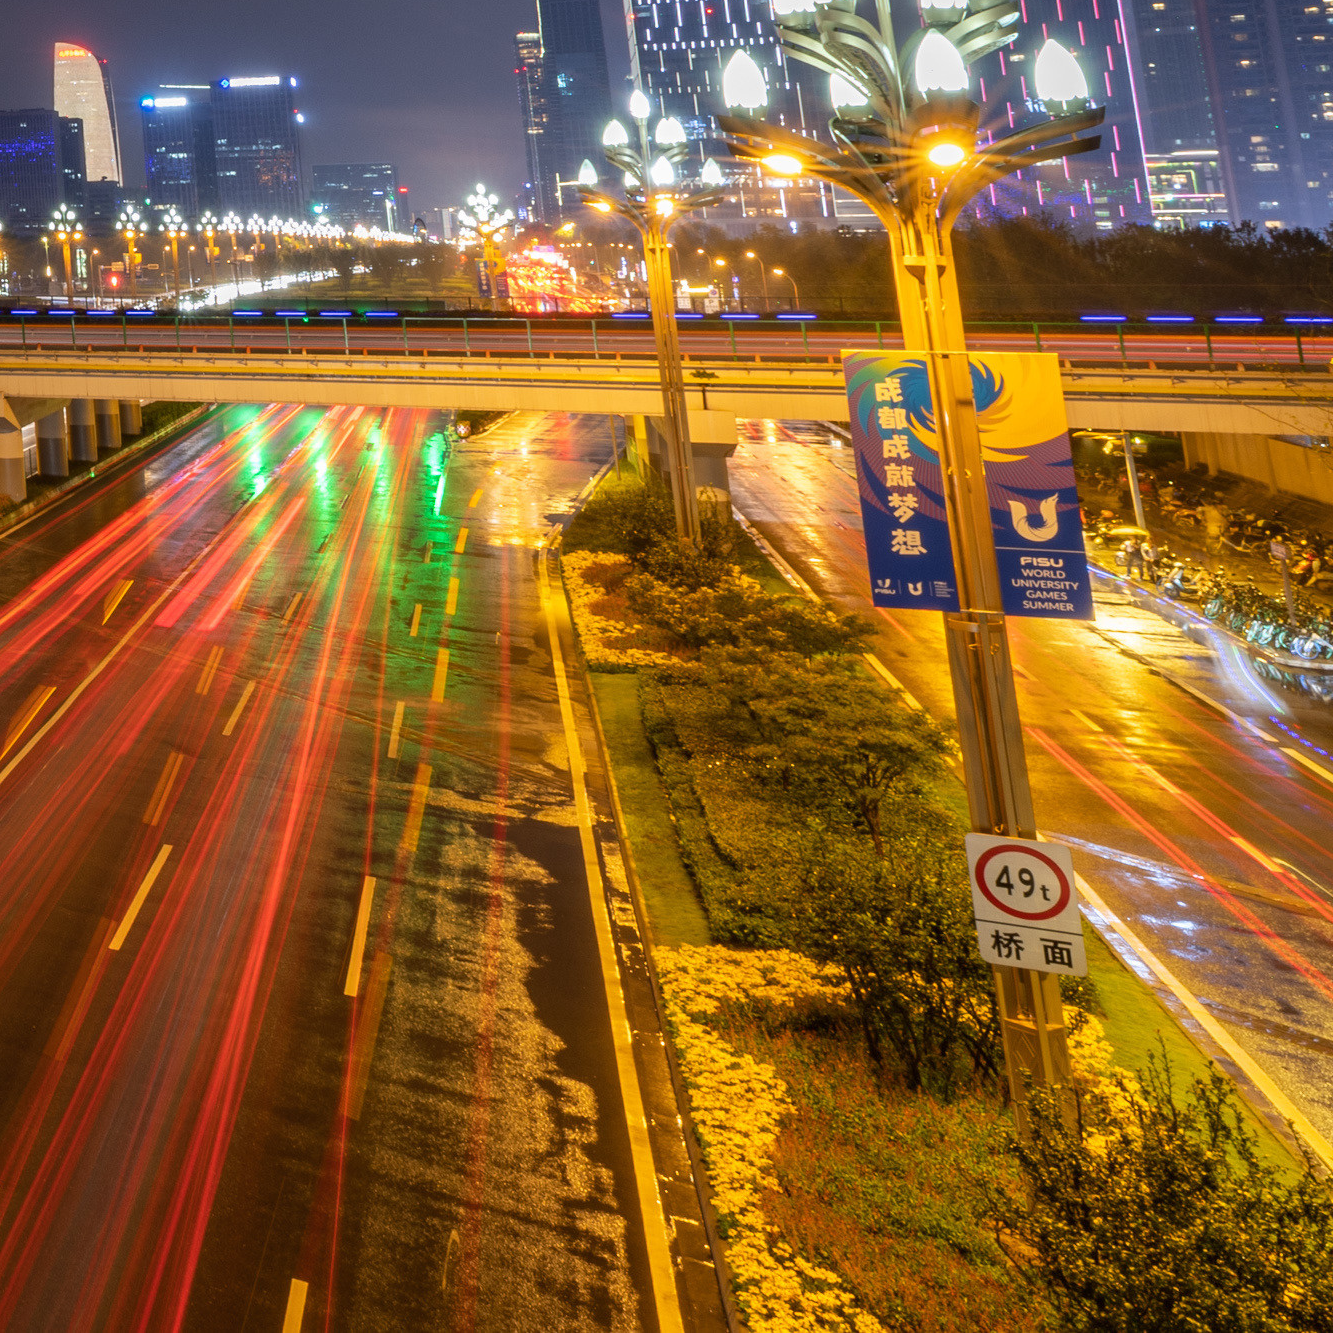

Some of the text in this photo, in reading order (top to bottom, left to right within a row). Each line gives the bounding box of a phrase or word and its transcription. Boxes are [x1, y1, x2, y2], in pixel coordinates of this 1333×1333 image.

[875, 377, 927, 555] 成都成就梦想
[1020, 557, 1063, 568] FISU
[1021, 568, 1066, 579] WORLD
[1011, 578, 1079, 591] UNIVERSITY
[1026, 590, 1068, 601] GAMES
[1023, 600, 1075, 612] SUMMER
[991, 929, 1073, 969] 桥面
